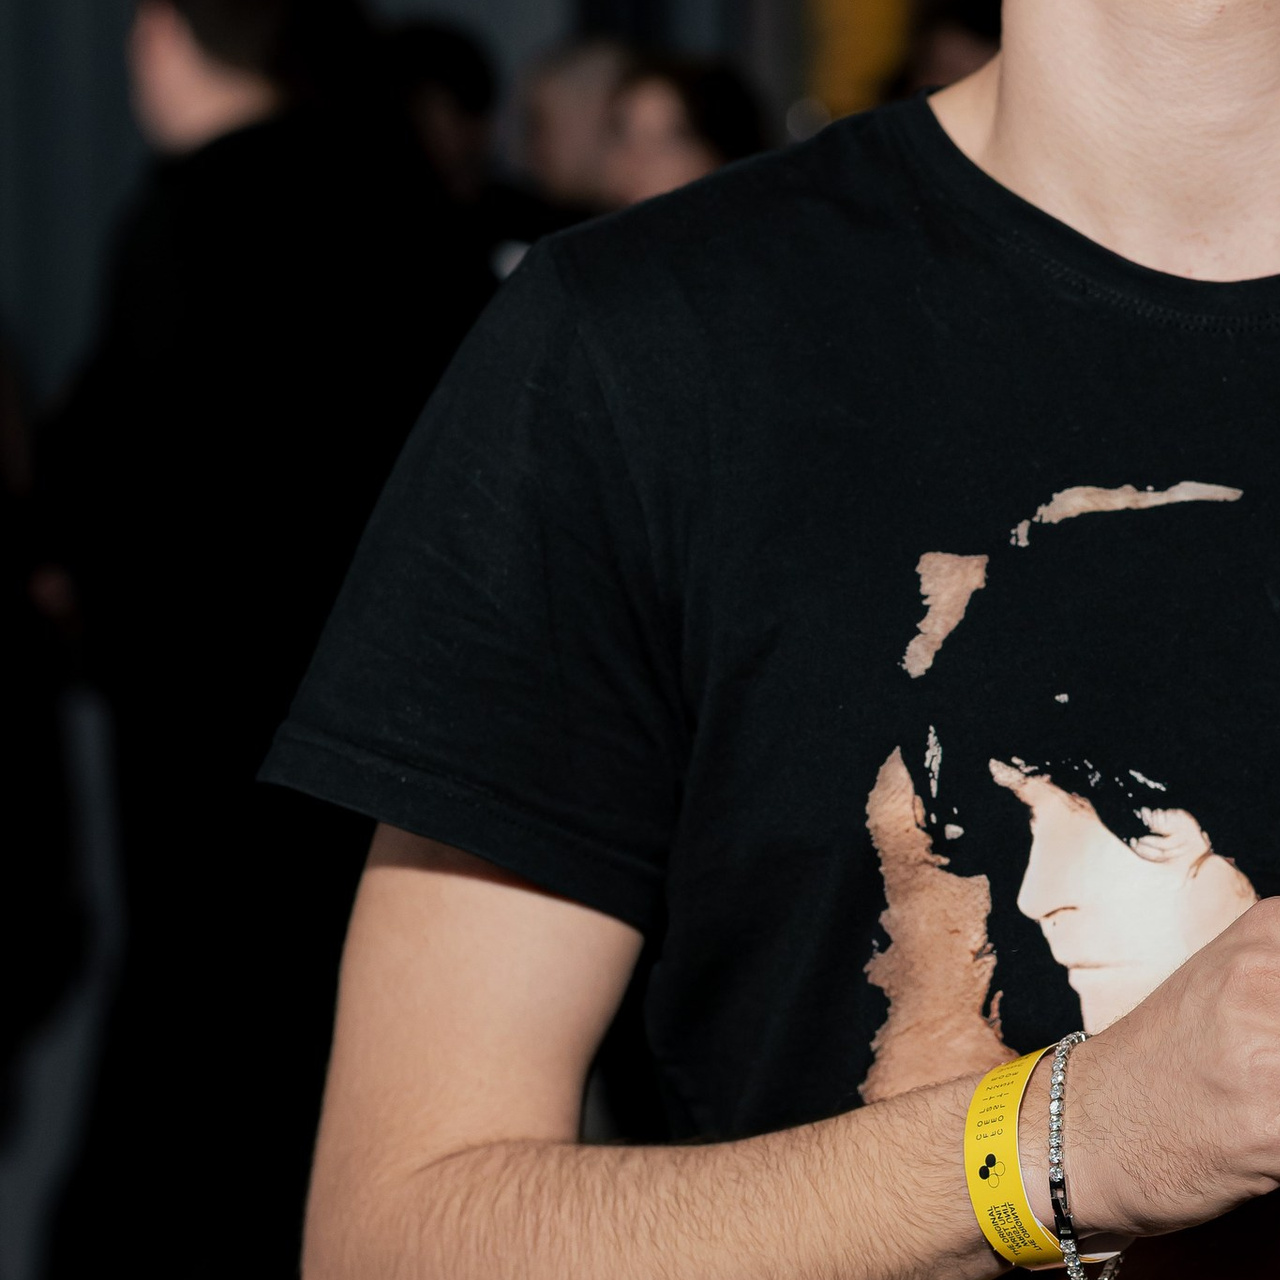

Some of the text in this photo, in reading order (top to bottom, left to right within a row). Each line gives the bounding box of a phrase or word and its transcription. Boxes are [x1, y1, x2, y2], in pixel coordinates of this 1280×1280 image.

[987, 1206, 1009, 1244] ORIGINAL
[993, 1205, 1022, 1248] WRIST UNIT
